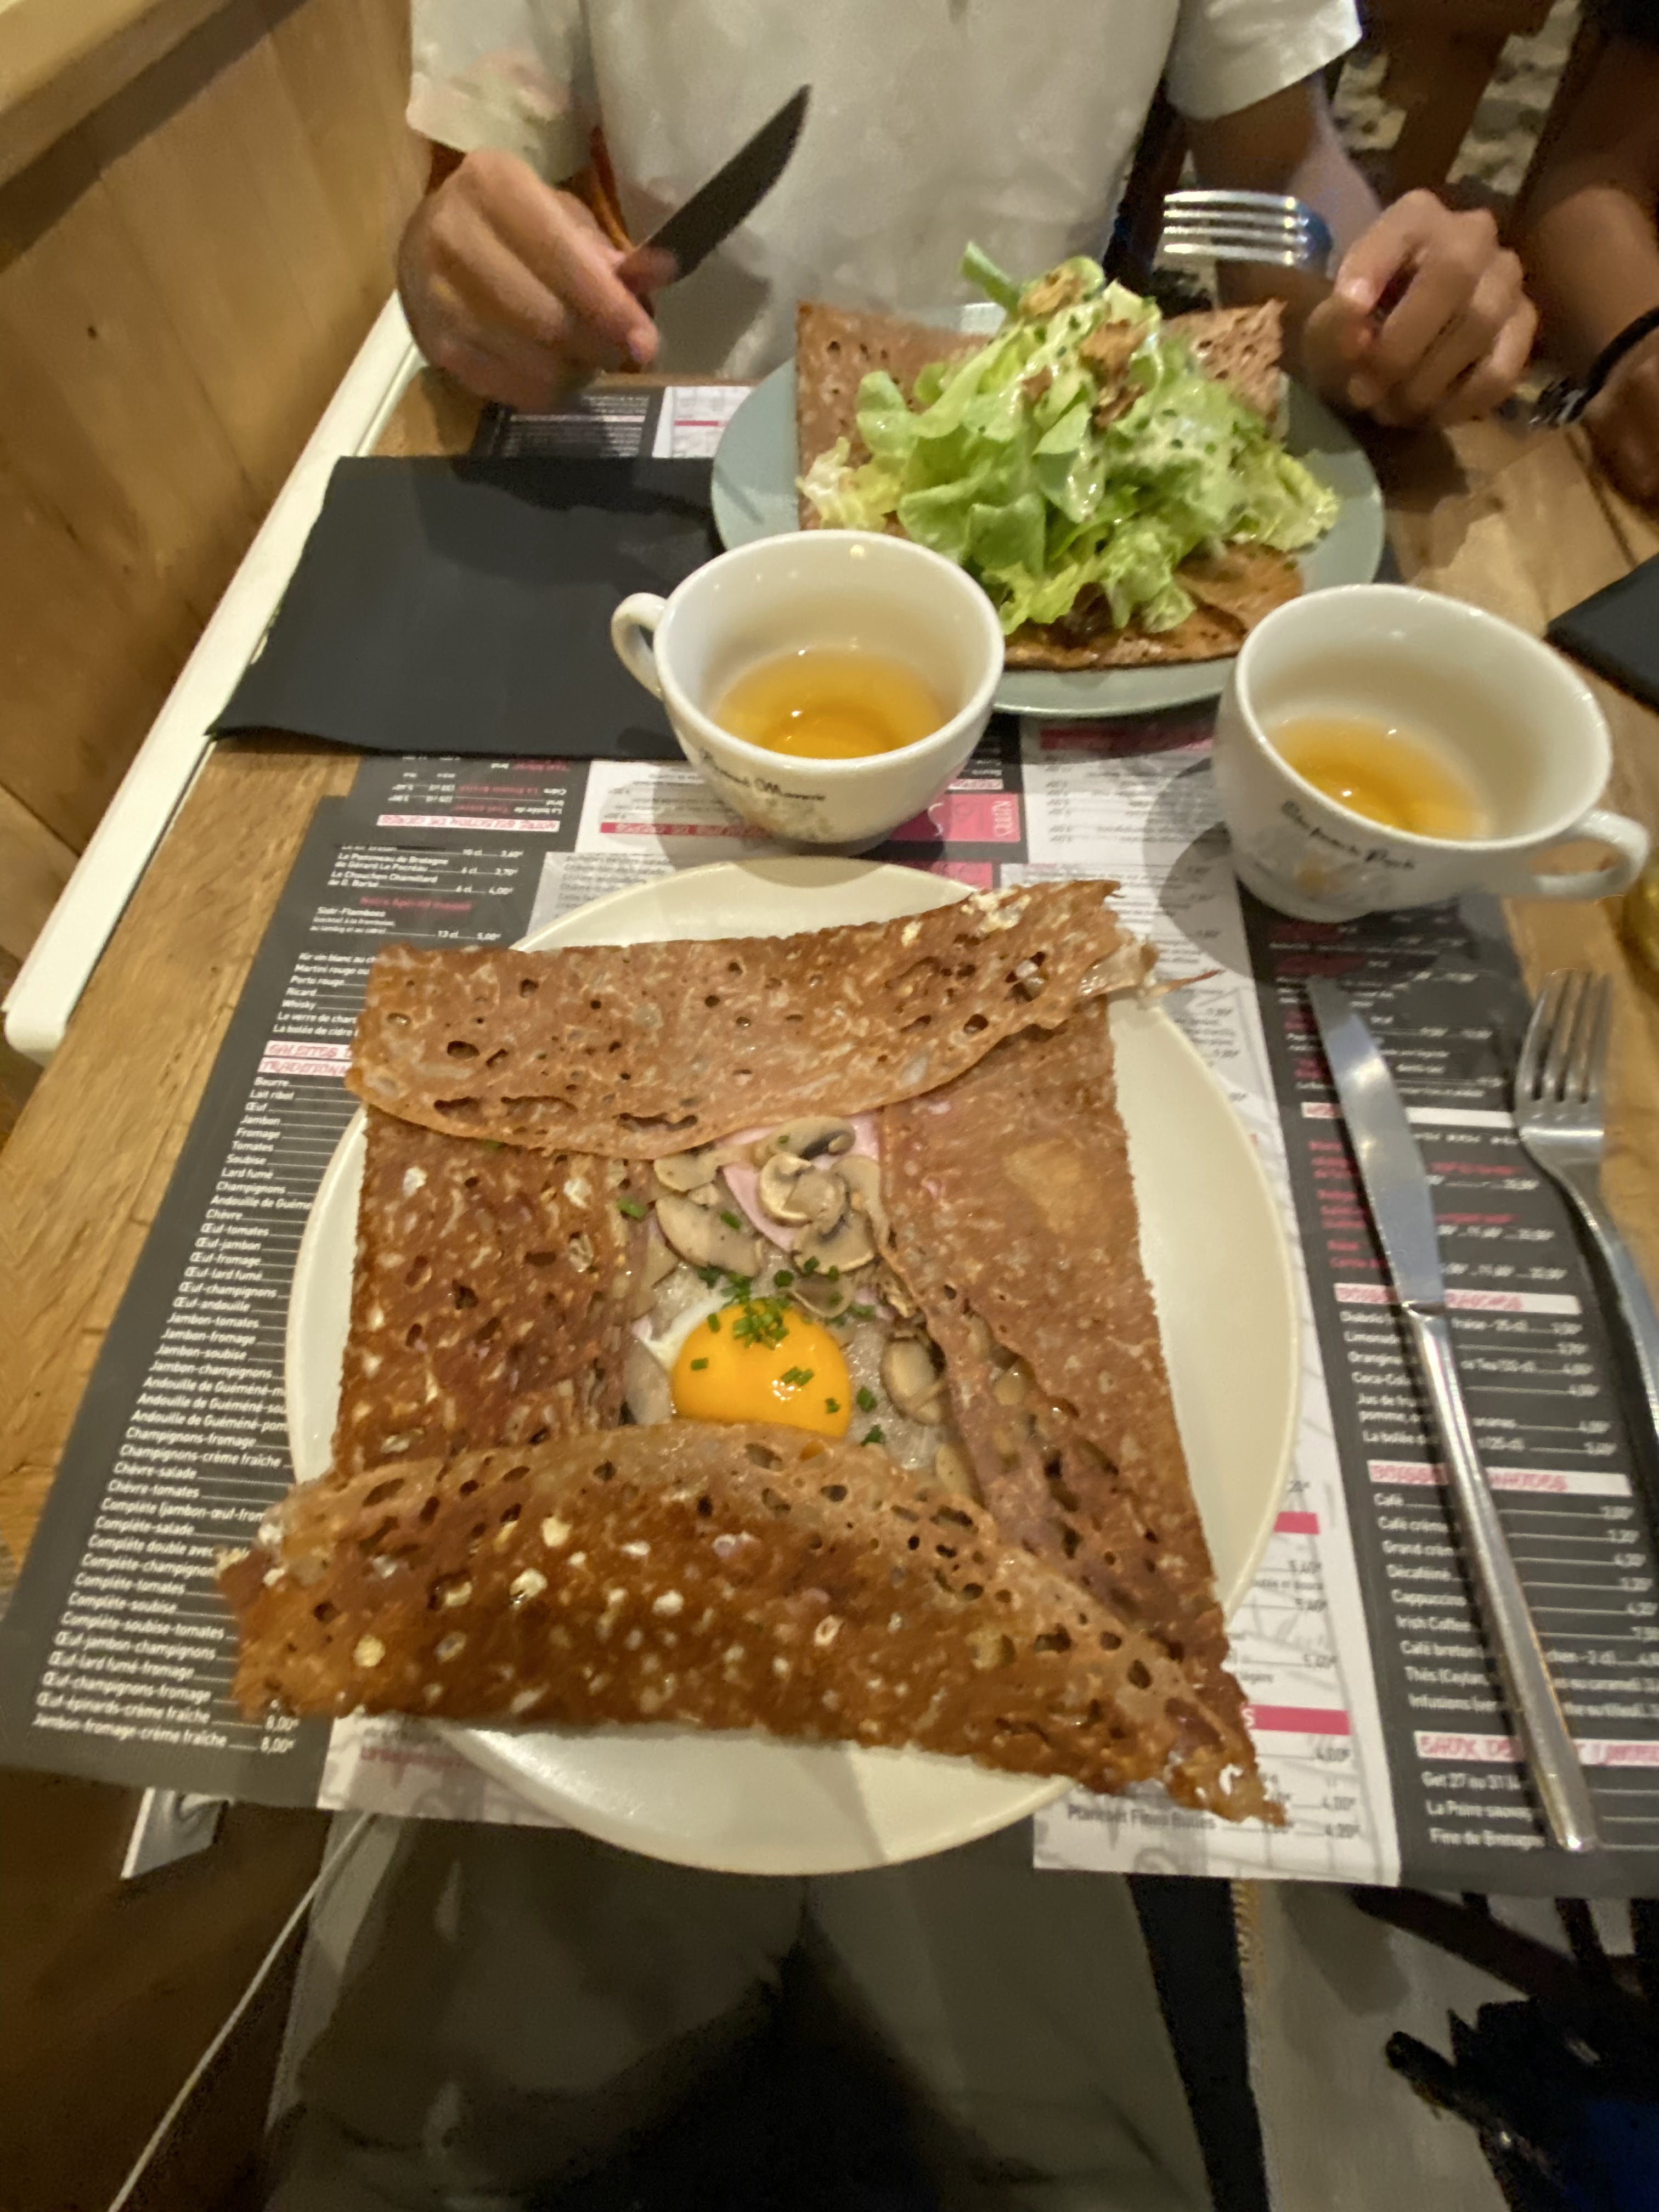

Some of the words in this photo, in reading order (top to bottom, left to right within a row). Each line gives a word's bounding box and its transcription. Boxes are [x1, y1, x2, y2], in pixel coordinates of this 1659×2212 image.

[286, 987, 318, 996] Ricard
[281, 999, 317, 1011] Whisky
[253, 1076, 290, 1087] Beurre
[240, 1114, 281, 1125] Jambon
[235, 1127, 281, 1140] Fromage
[232, 1140, 274, 1152] Tomates
[225, 1153, 267, 1164] Soubise
[221, 1167, 246, 1178] Lard
[216, 1181, 286, 1195] Champignons
[210, 1195, 260, 1207] Andouille
[261, 1198, 274, 1207] de
[166, 1312, 259, 1328] Jambon-tomates
[160, 1328, 256, 1347] Jambon-fromage
[154, 1343, 247, 1360] Jambon-soubise
[149, 1359, 273, 1379] Jambon-champignons
[142, 1376, 197, 1391] Andouille
[198, 1380, 213, 1391] de
[137, 1393, 191, 1408] Andouille
[192, 1396, 207, 1409] de
[130, 1409, 186, 1425] Andouille
[187, 1414, 202, 1426] de
[125, 1426, 257, 1449] Champignons-fromage
[146, 1540, 187, 1555] double
